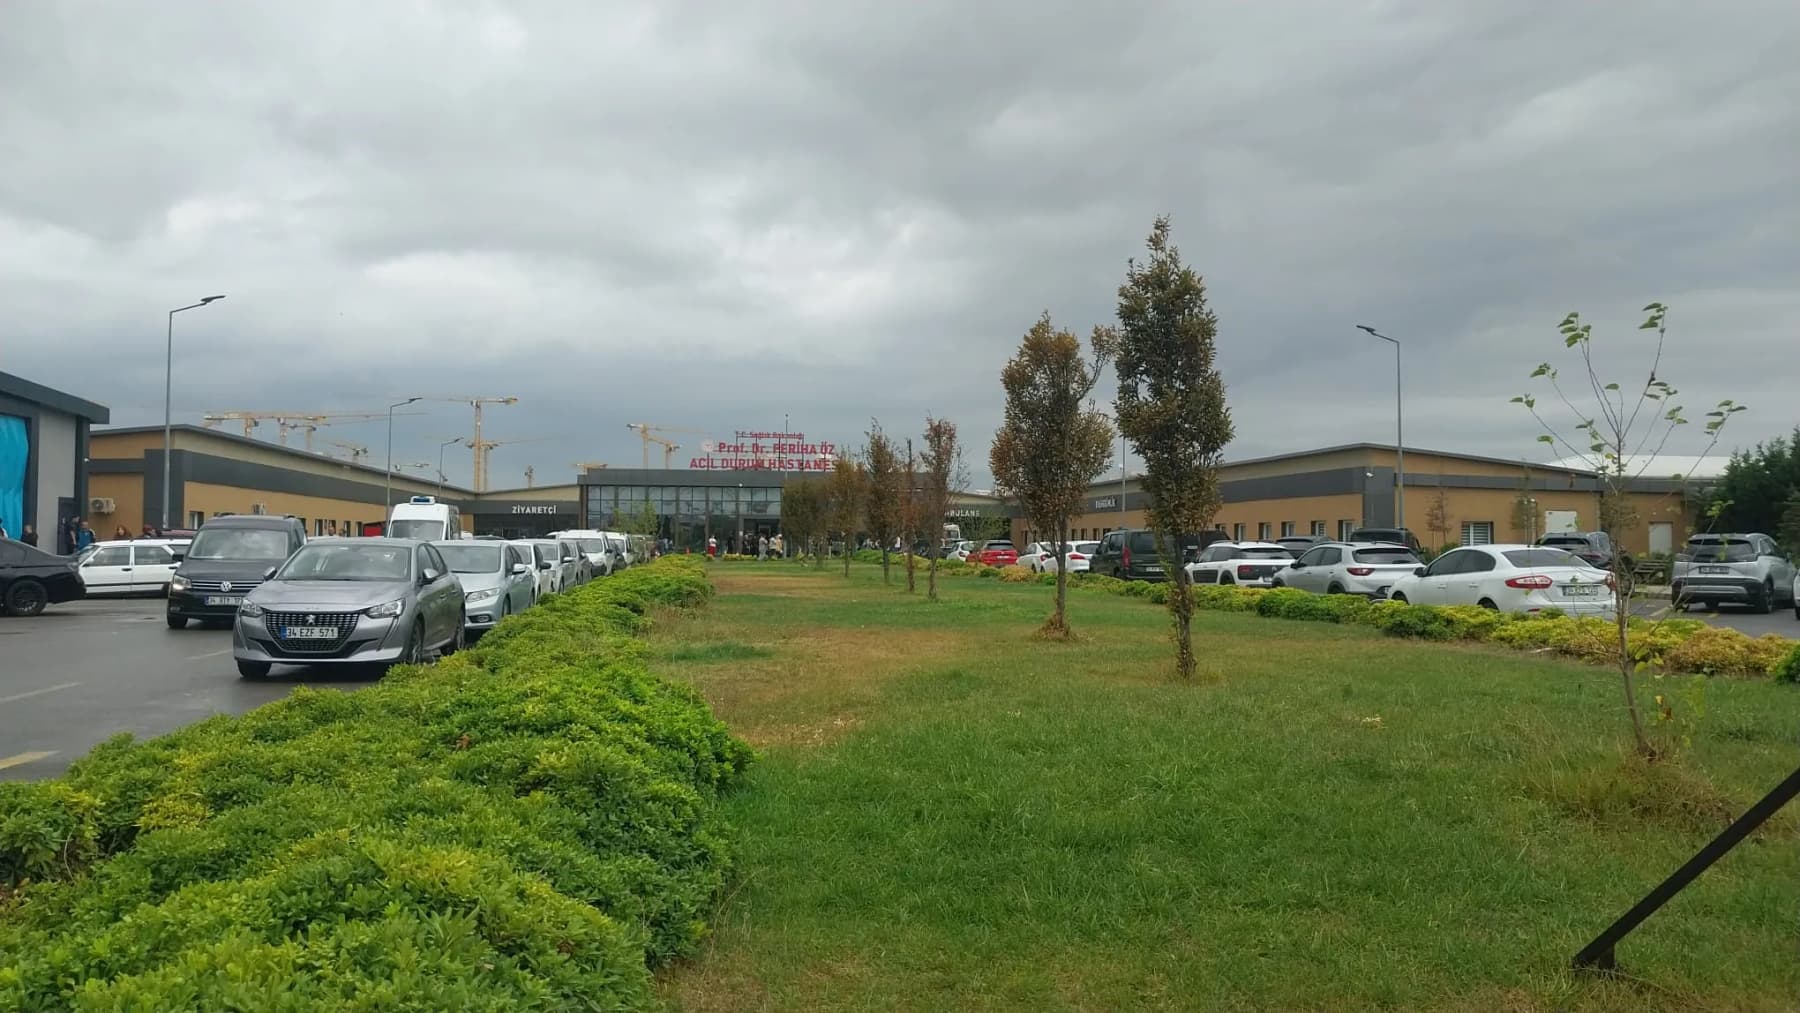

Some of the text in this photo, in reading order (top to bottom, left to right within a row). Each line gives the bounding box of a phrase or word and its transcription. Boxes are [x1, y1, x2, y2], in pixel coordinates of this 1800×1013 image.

[718, 440, 835, 455] Prof. Dr. FERİHA ÖZ
[689, 457, 715, 468] ACİL
[721, 458, 764, 469] DURUM
[512, 504, 557, 515] ZİYARETÇİ
[287, 628, 334, 637] 34 EZF 571
